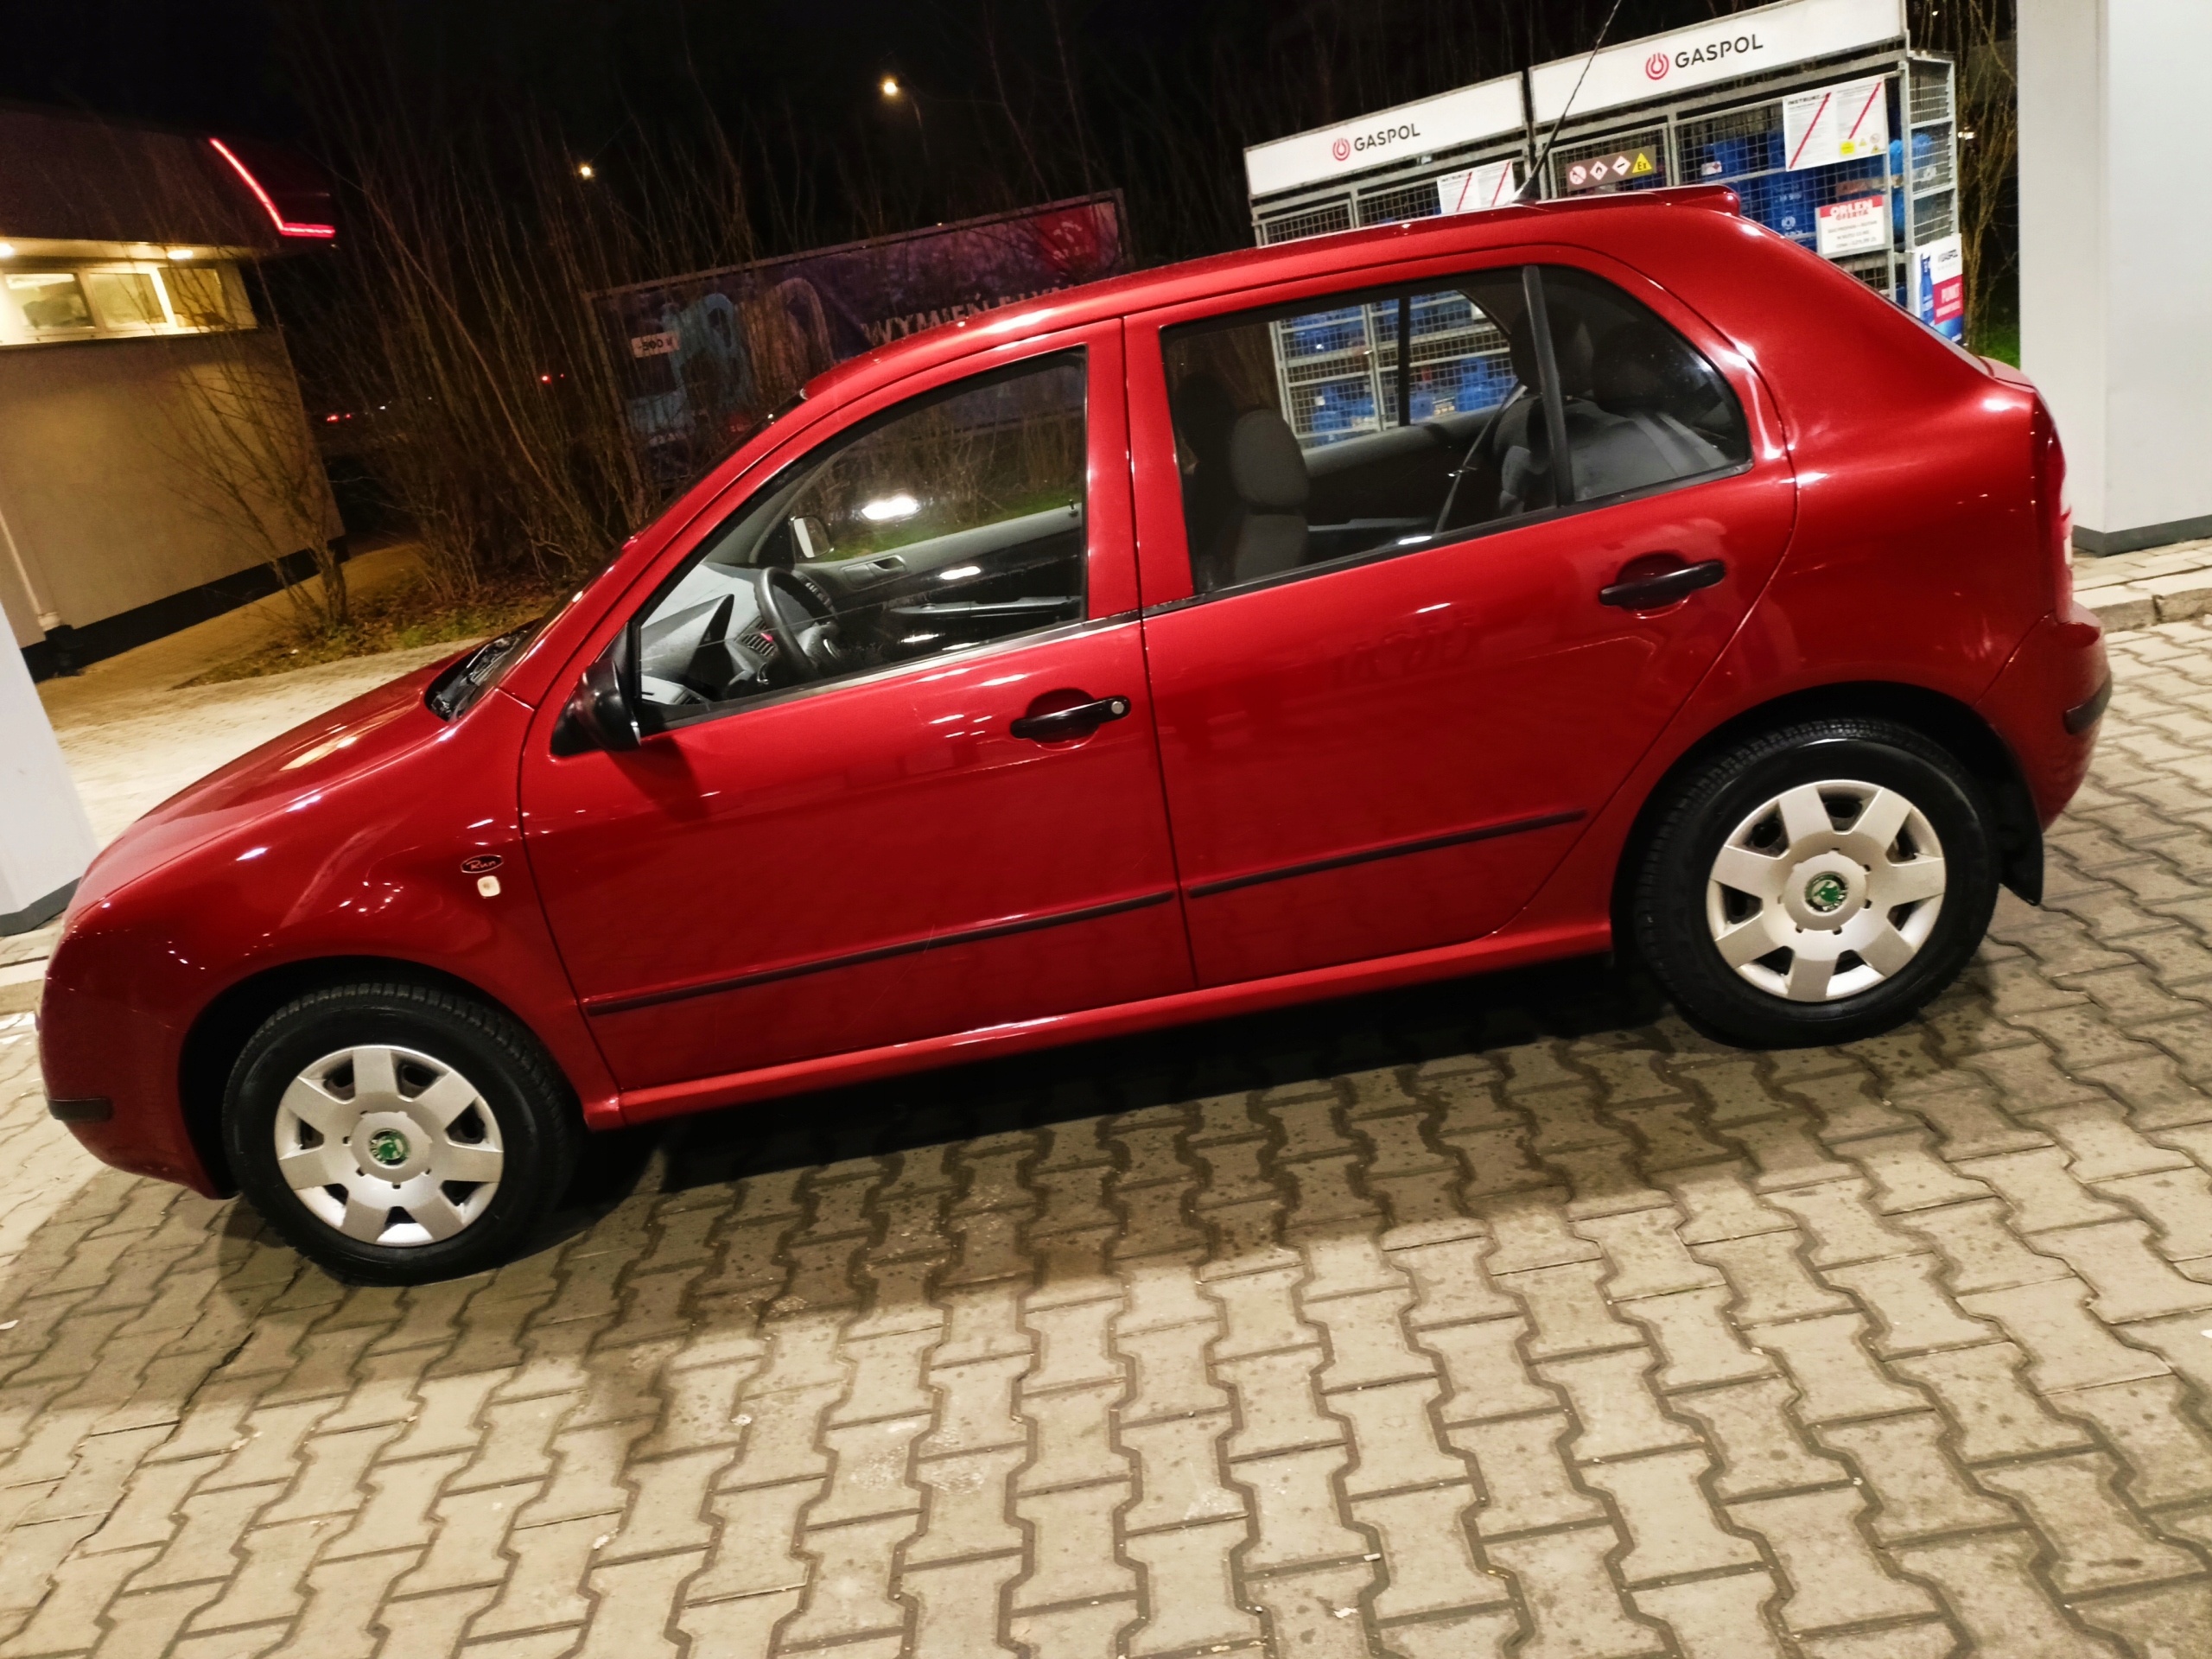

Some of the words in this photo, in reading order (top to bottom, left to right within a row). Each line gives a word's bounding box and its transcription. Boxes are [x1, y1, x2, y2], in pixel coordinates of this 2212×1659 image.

[1675, 34, 1764, 68] GASPOL
[1354, 124, 1421, 151] GASPOL
[1830, 199, 1873, 216] ORLEN
